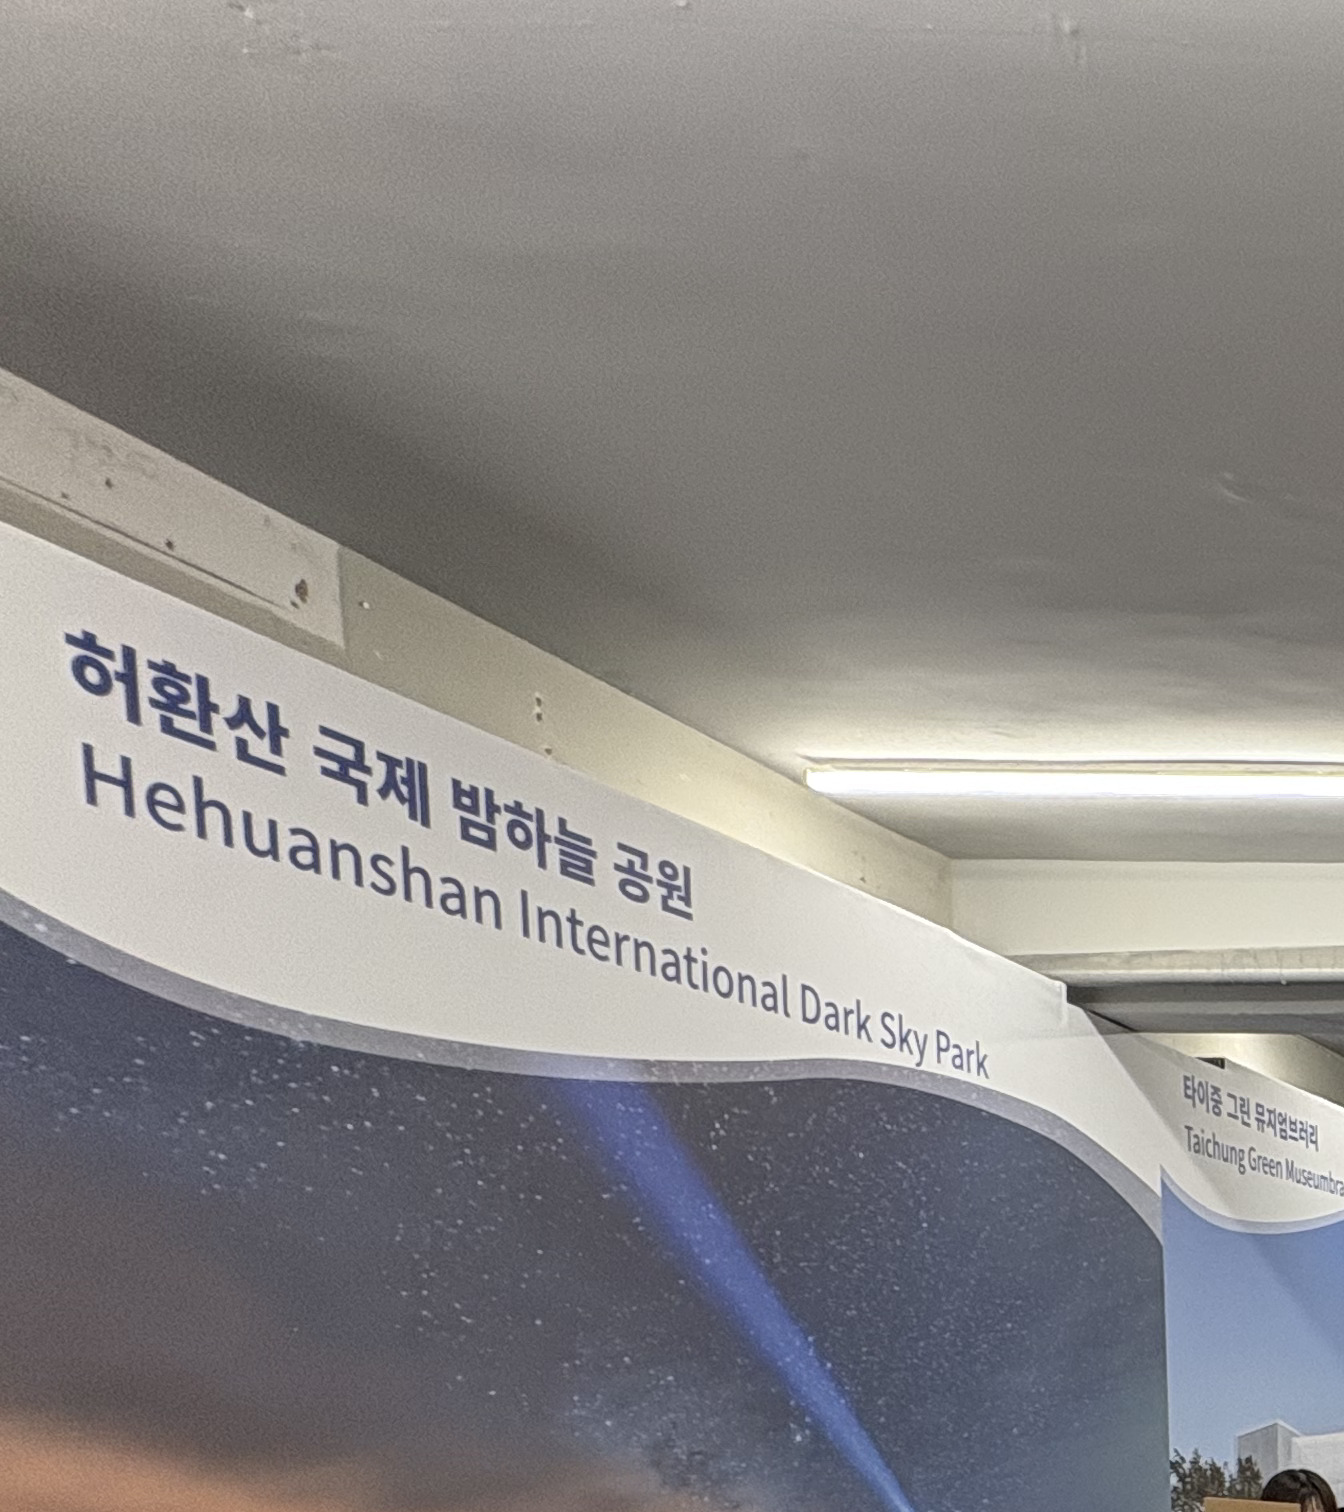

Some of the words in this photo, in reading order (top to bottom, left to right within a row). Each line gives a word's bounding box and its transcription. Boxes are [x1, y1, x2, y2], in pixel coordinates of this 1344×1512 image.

[64, 629, 290, 775] 허환산
[314, 724, 431, 829] 국제
[451, 776, 597, 887] 밤하늘
[612, 839, 694, 921] 공원
[82, 743, 503, 931] Hehuanshan
[521, 887, 789, 1020] International
[801, 982, 872, 1044] Dark
[880, 1012, 928, 1067] Sky
[935, 1027, 990, 1080] Park
[1183, 1075, 1223, 1117] 타이중
[1227, 1093, 1251, 1127] 그린
[1255, 1103, 1319, 1151] 뮤지엄브러리
[1185, 1125, 1246, 1175] Taichung
[1249, 1147, 1283, 1179] Green
